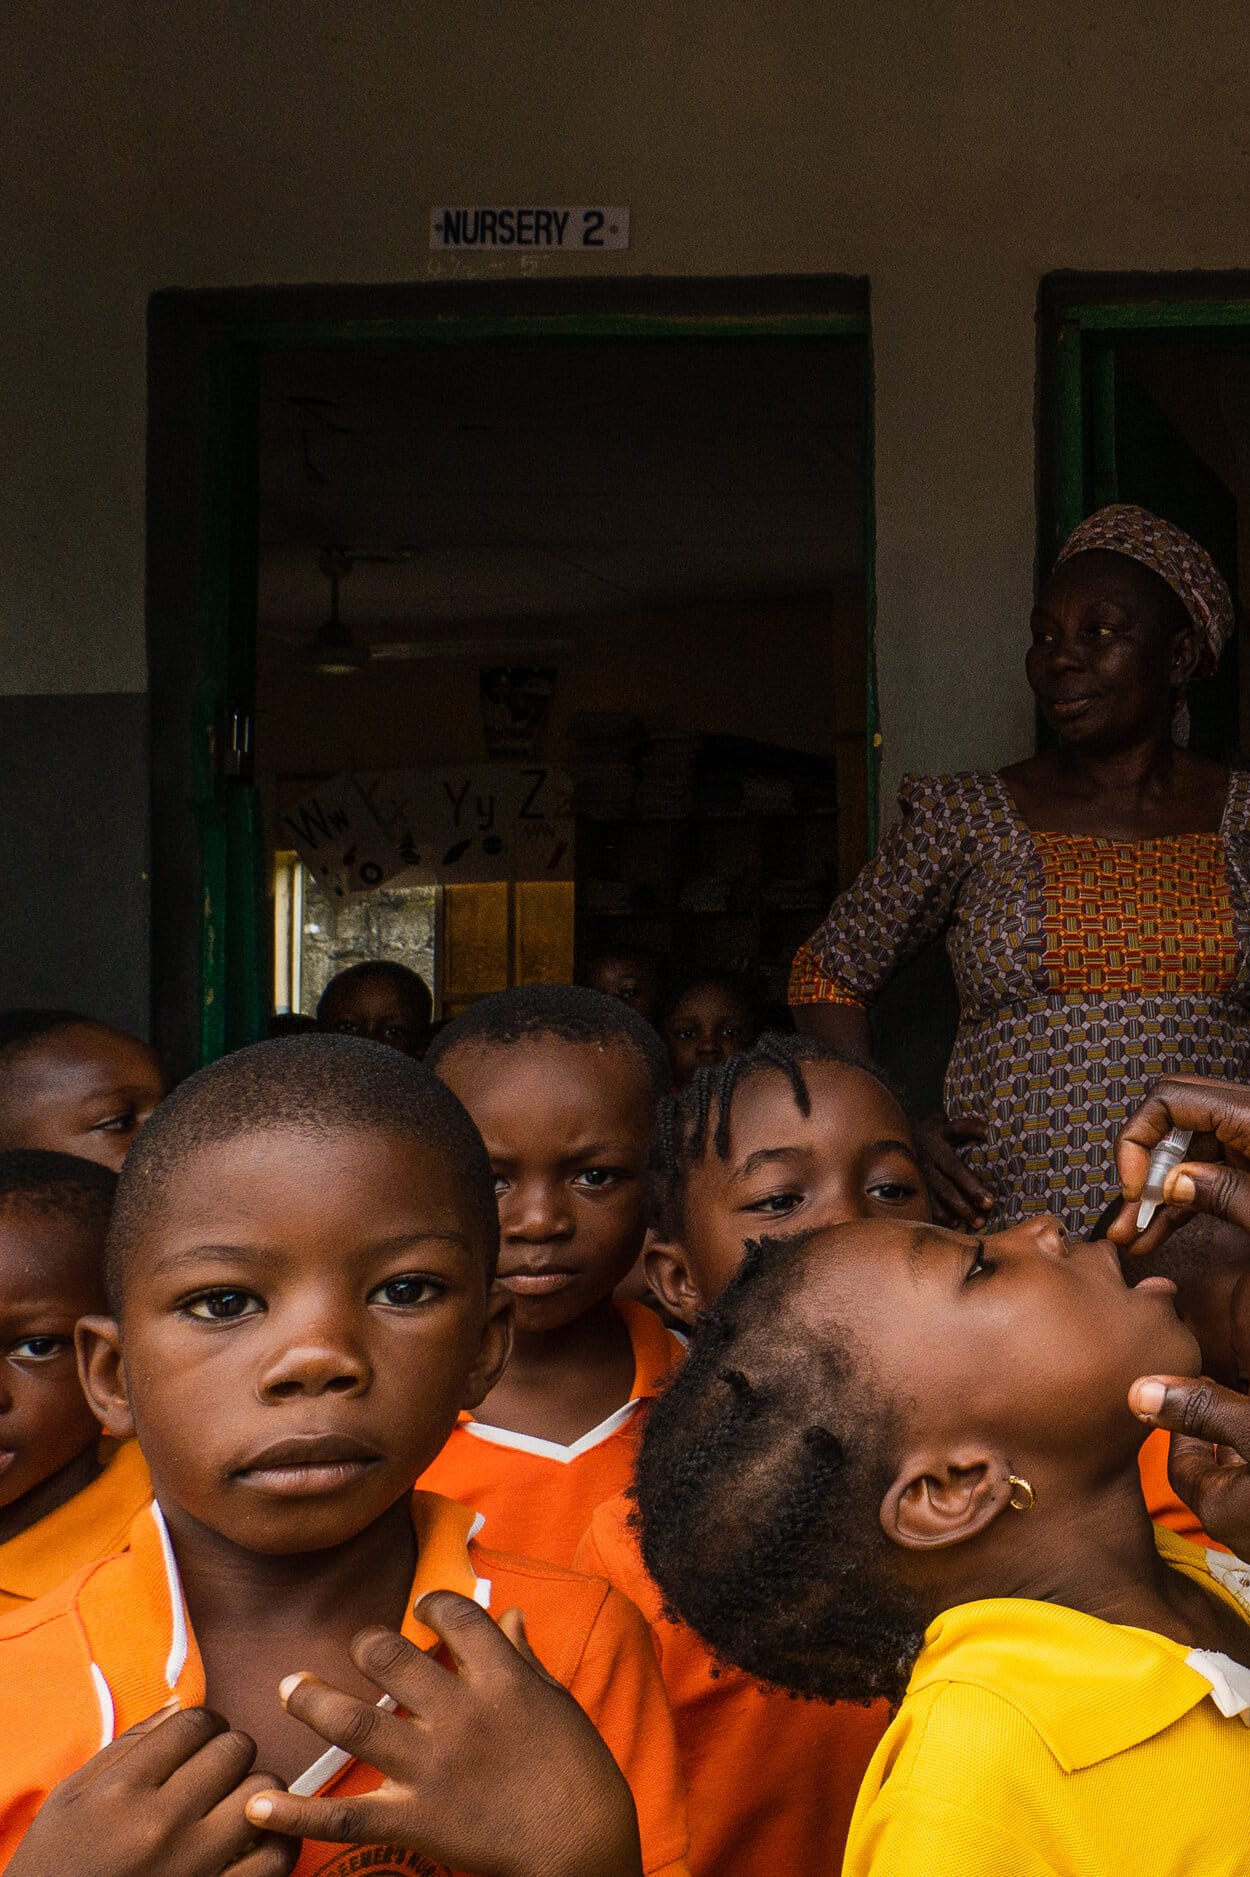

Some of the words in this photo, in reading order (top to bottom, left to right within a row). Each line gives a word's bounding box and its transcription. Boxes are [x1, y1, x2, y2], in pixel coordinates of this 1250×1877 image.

[443, 209, 570, 246] NURSERY
[583, 210, 604, 246] 2
[443, 780, 496, 830] Yy
